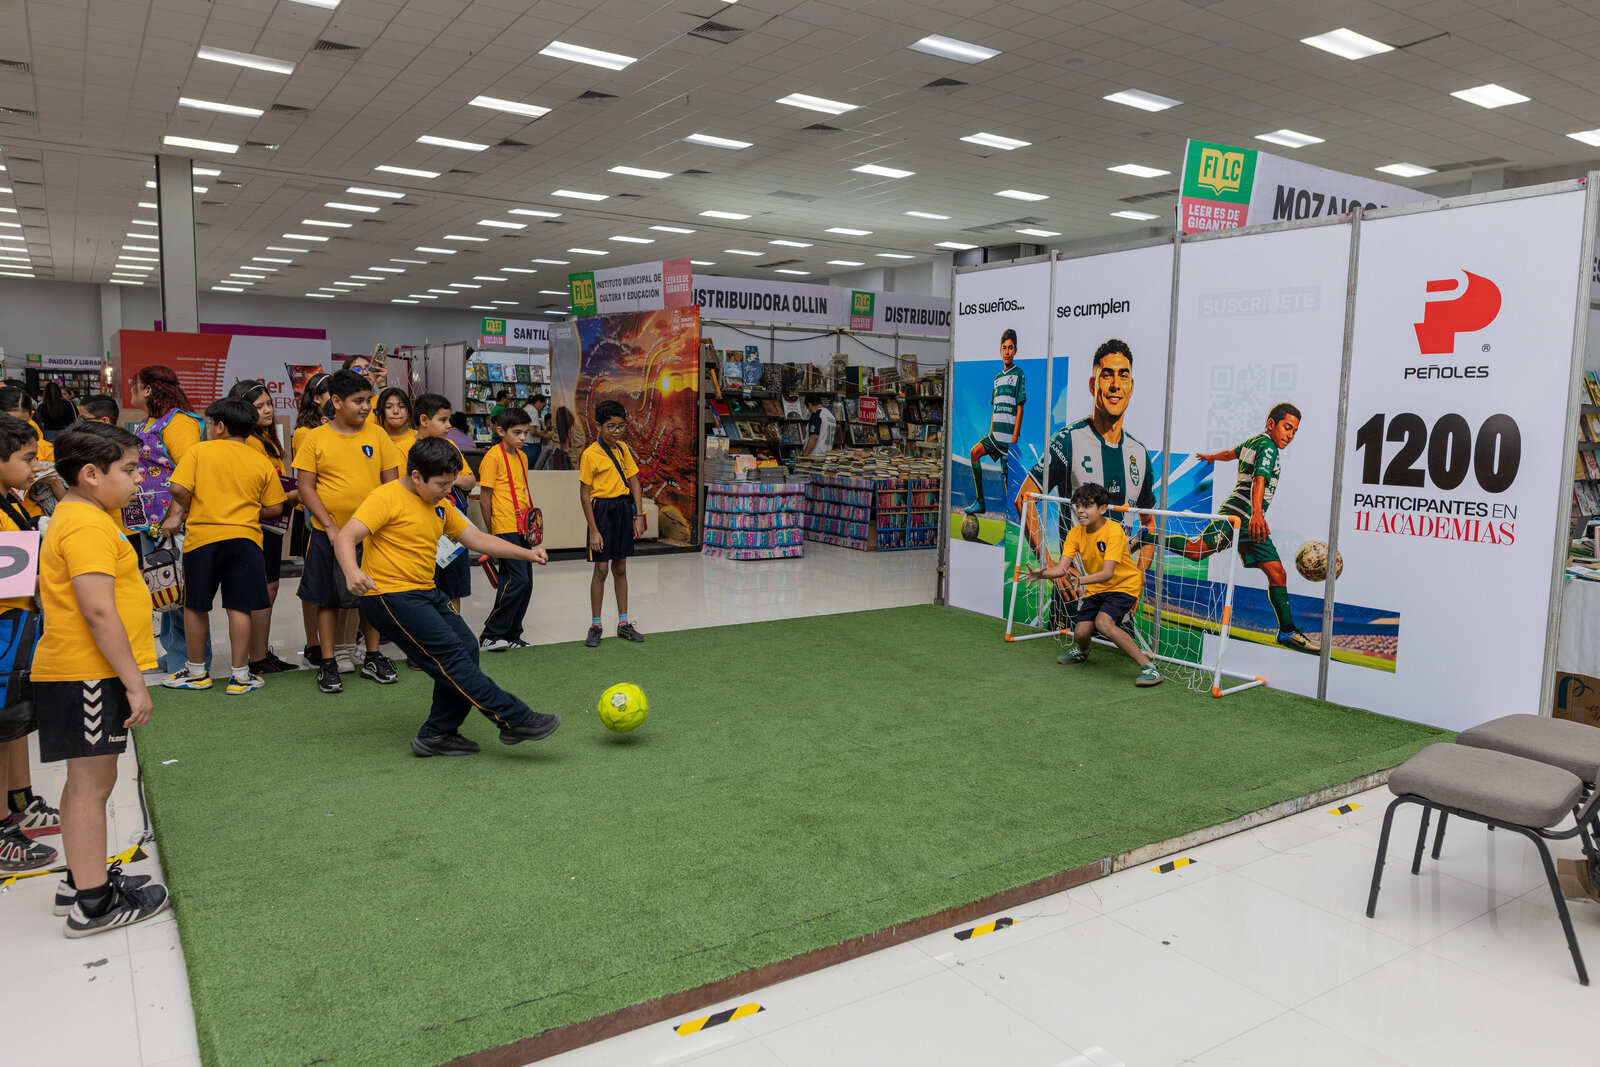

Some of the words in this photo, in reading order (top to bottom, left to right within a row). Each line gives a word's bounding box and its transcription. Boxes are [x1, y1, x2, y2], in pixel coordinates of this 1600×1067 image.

[1189, 203, 1212, 218] LEER
[1213, 207, 1226, 219] ES
[1227, 208, 1240, 221] DE
[1187, 215, 1239, 231] GIGANTES
[596, 279, 622, 289] INSTITUTO
[622, 274, 653, 286] MUNICIPAL
[653, 273, 662, 282] DE
[665, 283, 689, 293] GIGANTES
[599, 292, 621, 303] CULTURA
[622, 292, 626, 300] Y
[627, 287, 660, 300] EDUCACIÓN
[792, 295, 828, 314] OLLIN
[959, 302, 977, 315] Los
[978, 297, 1025, 314] sueños...
[1056, 305, 1071, 318] se
[1073, 298, 1130, 318] cumplen
[1404, 364, 1490, 379] PEÑOLES
[1356, 412, 1521, 494] 1200
[1354, 493, 1488, 517] PARTICIPANTES
[1492, 503, 1517, 519] EN
[1354, 510, 1371, 531] 11
[1375, 511, 1515, 546] ACADEMIAS
